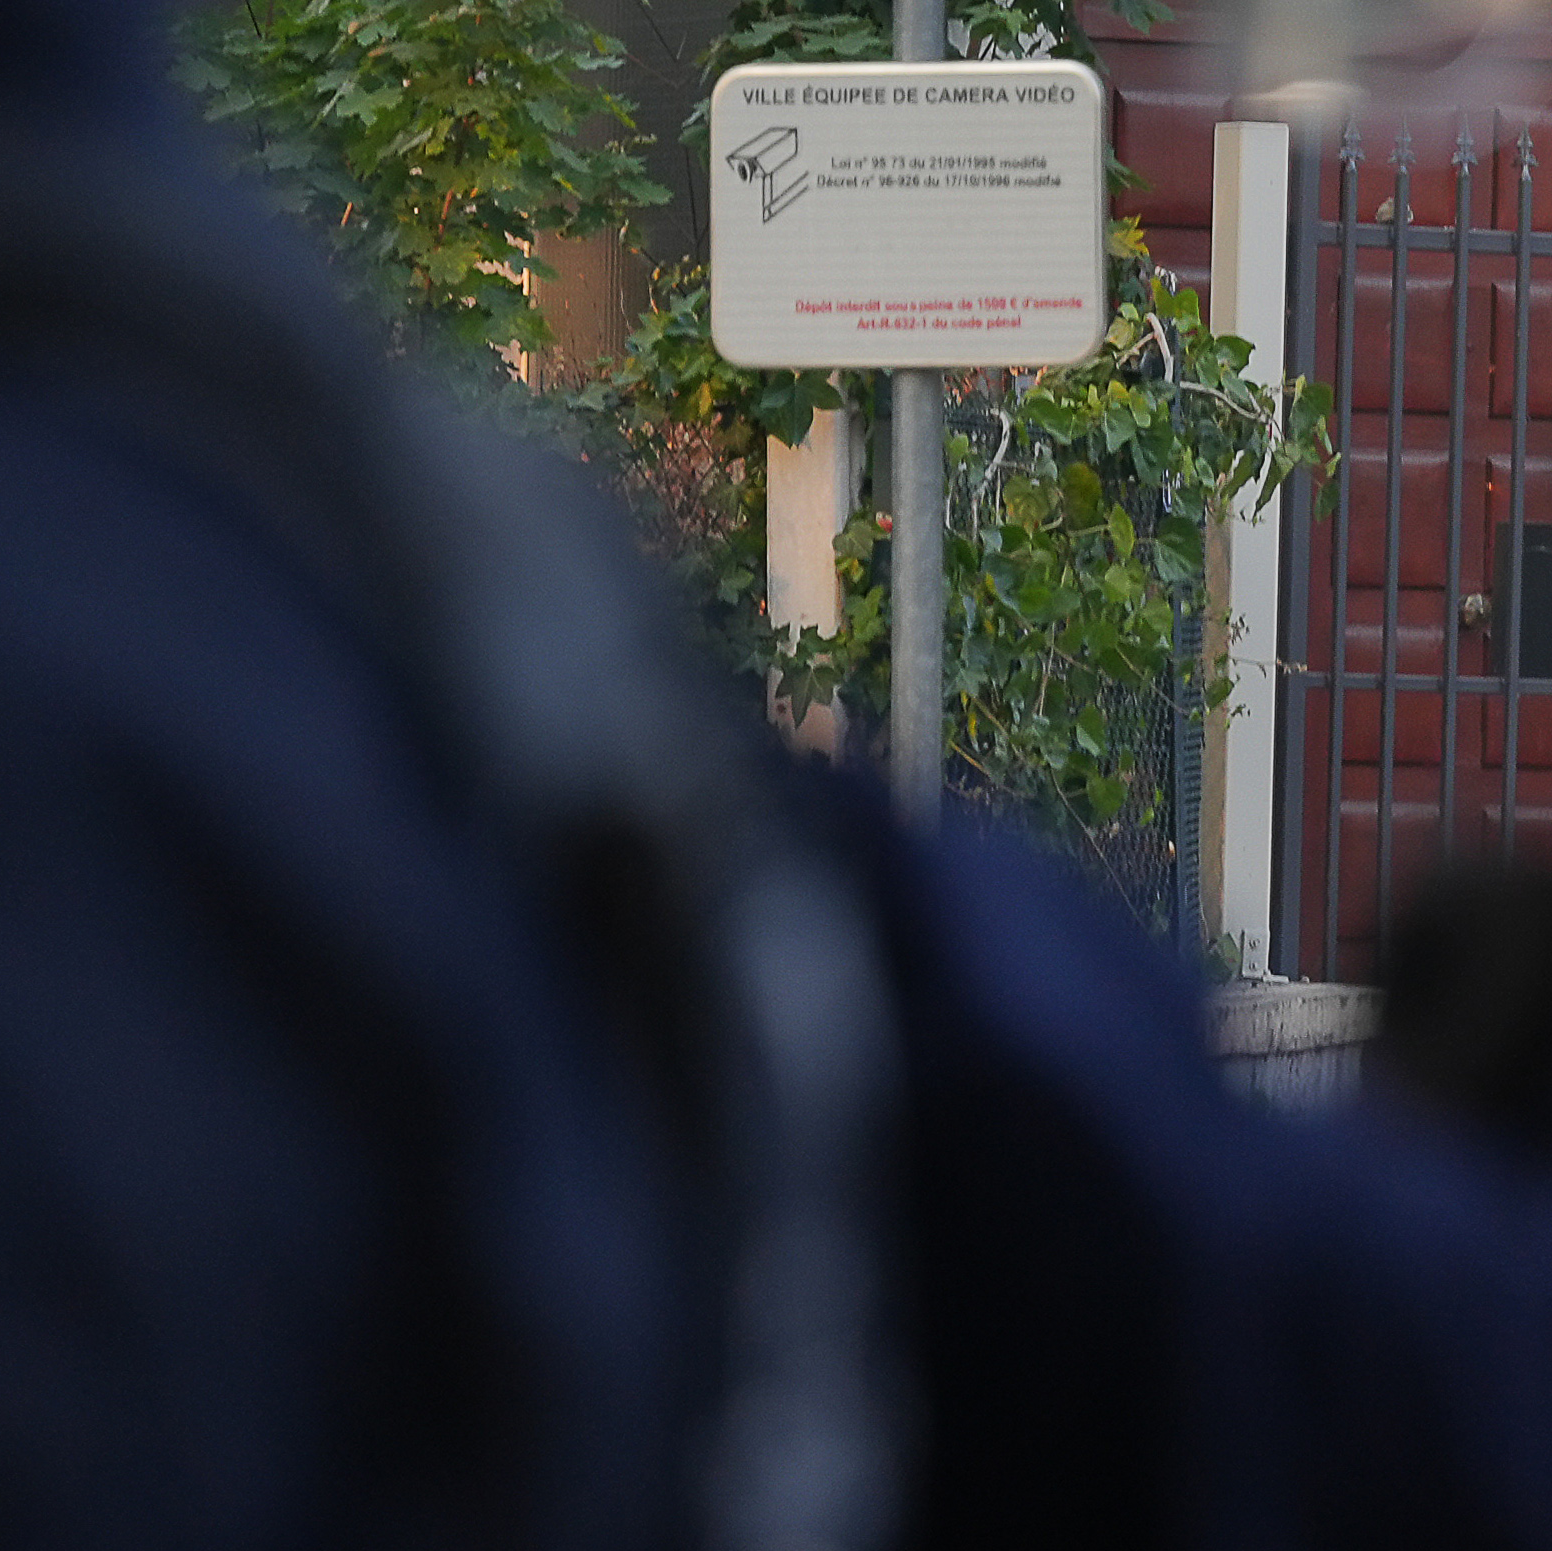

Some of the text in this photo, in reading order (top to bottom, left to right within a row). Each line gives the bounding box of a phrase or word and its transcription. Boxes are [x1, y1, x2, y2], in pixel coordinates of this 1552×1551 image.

[743, 87, 795, 105] VILLE
[893, 87, 918, 104] DE
[1017, 84, 1075, 103] VIDÉO
